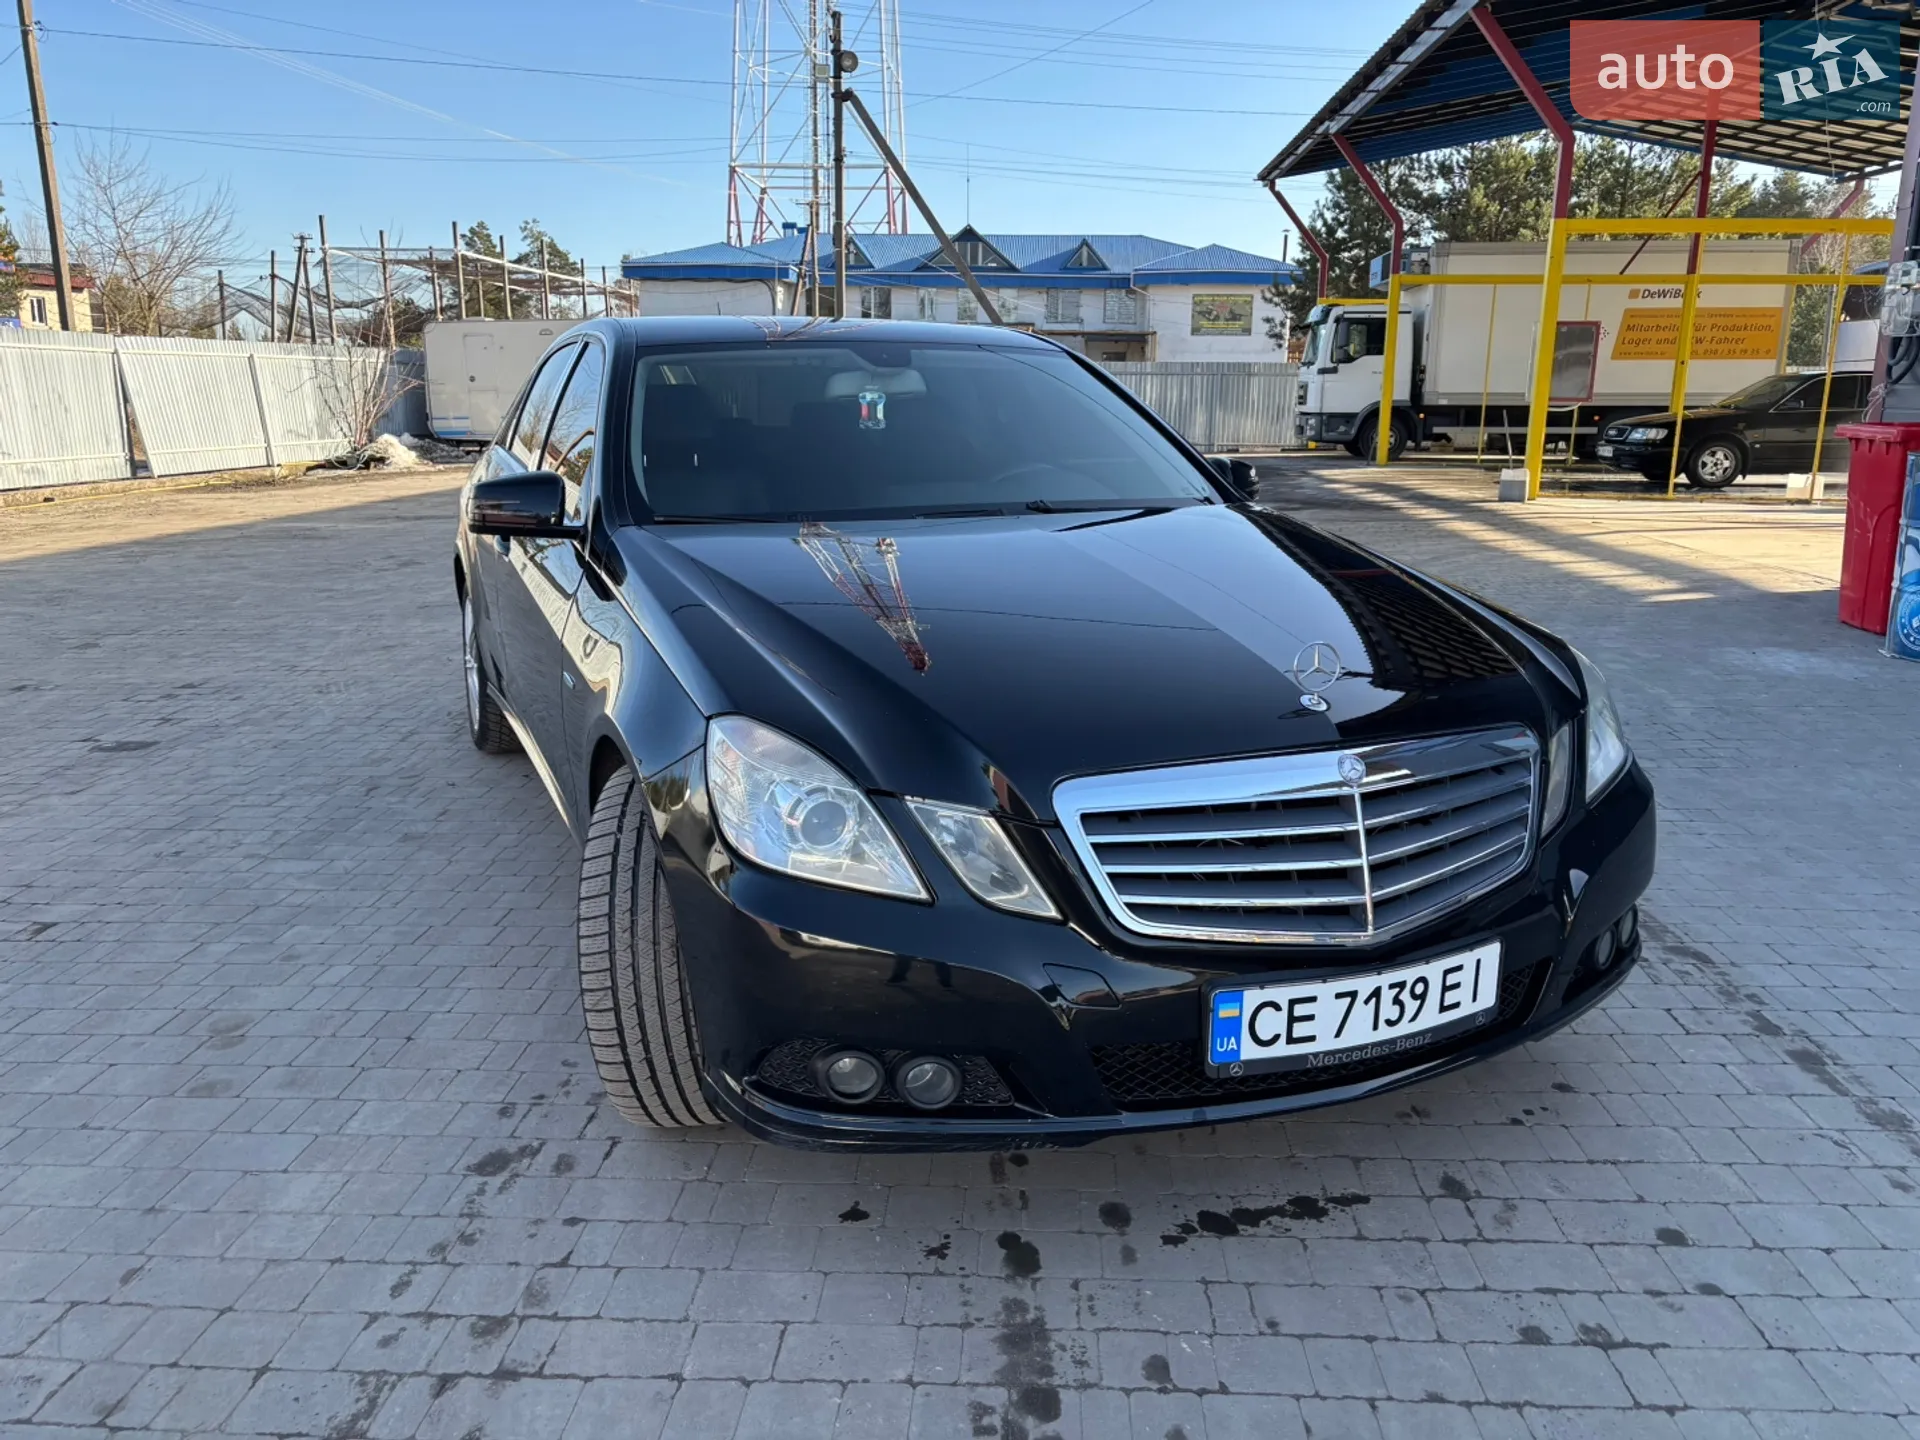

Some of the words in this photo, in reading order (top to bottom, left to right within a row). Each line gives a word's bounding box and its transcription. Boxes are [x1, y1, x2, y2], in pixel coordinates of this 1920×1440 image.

[1693, 322, 1706, 332] ür
[1710, 322, 1775, 334] Produktion,
[1621, 336, 1652, 347] Lager
[1656, 336, 1677, 345] und
[1247, 995, 1318, 1048] CE
[1333, 976, 1430, 1039] 7139
[1438, 958, 1482, 1014] EI
[1216, 1036, 1238, 1053] UA
[1306, 1032, 1433, 1069] Mercedes-Benz
